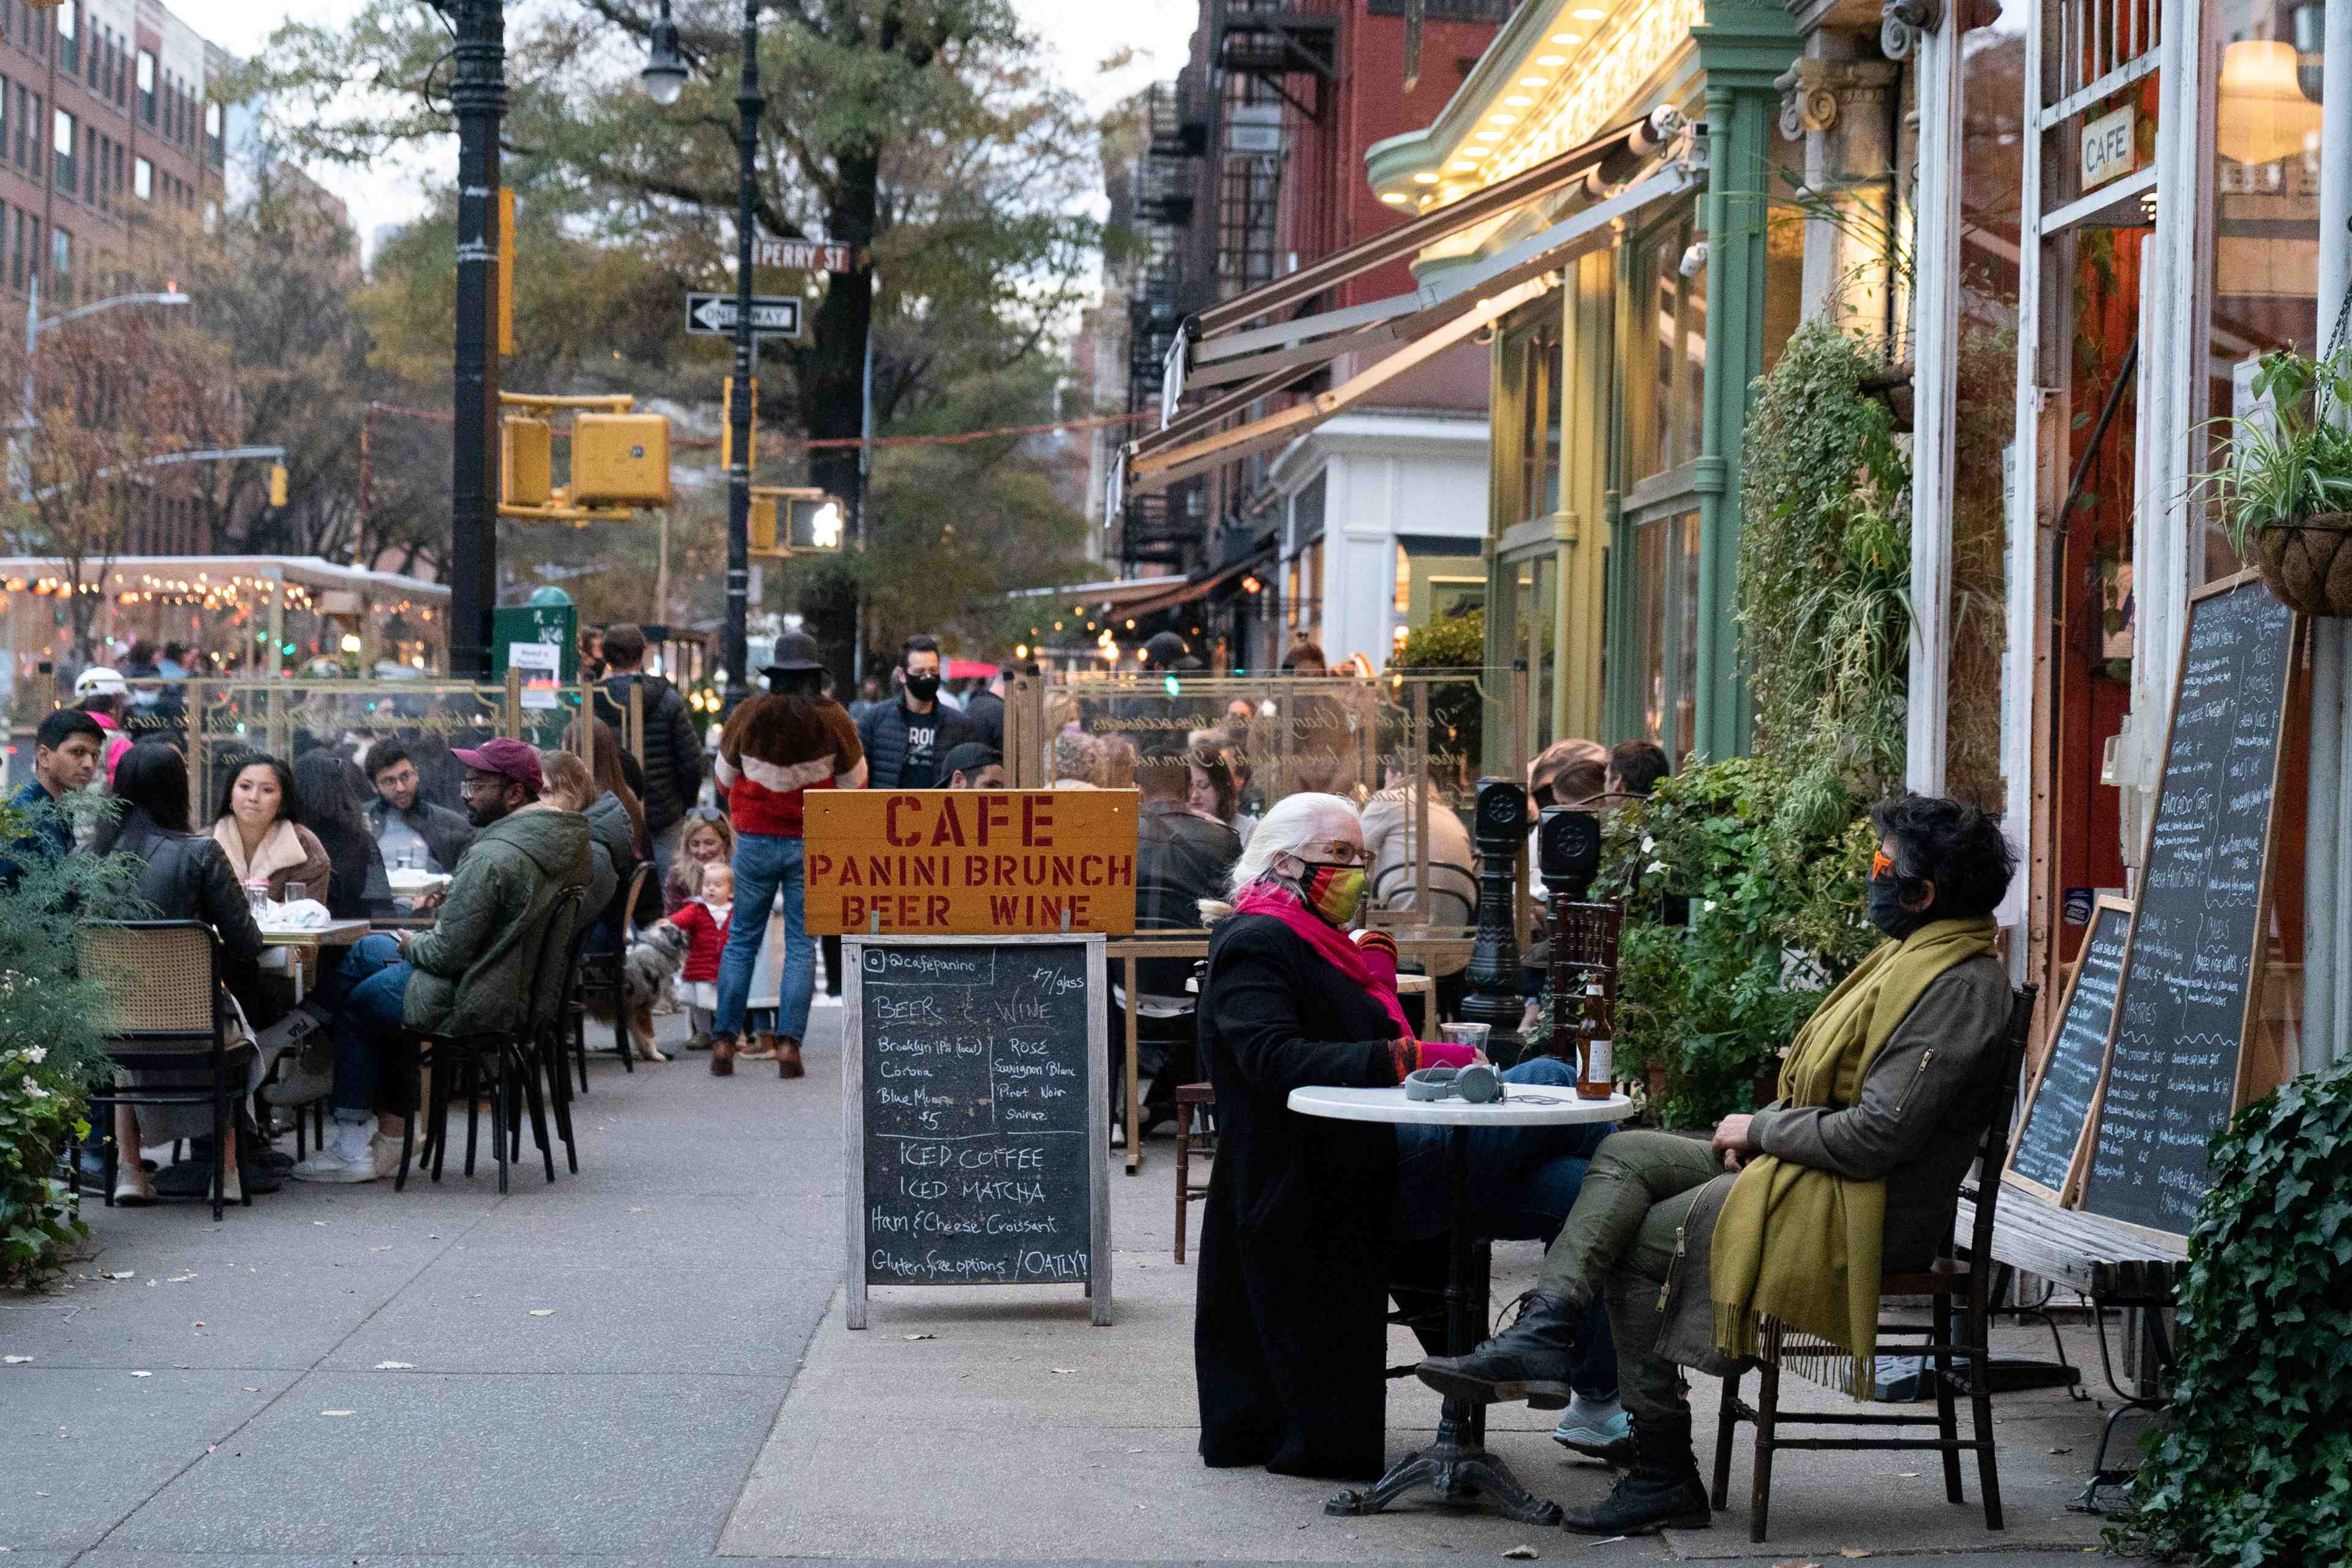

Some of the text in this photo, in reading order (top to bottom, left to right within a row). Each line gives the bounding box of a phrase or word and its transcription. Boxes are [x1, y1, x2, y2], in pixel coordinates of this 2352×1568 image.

[2086, 124, 2126, 173] CAFE
[761, 244, 843, 270] PERRY ST
[752, 308, 782, 320] WAY
[909, 726, 935, 746] ROI
[2162, 790, 2193, 816] AVOCADO
[886, 796, 1053, 847] CAFE
[810, 855, 1131, 886] PANINI BRUNCH
[842, 895, 1090, 926] BEER WINE
[873, 996, 944, 1020] BEER
[994, 988, 1052, 1023] WINE
[2124, 993, 2157, 1026] PASTRIES
[878, 1037, 932, 1057] Brooklyn
[881, 1061, 933, 1077] Corona
[994, 1058, 1076, 1079] Sauvignon Blanc
[877, 1087, 912, 1106] Blue
[997, 1083, 1066, 1101] Pinot Noir
[919, 1111, 941, 1131] $5
[900, 1142, 1044, 1169] ICED COFFEE
[900, 1175, 1044, 1205] ICED MATCHA
[872, 1205, 909, 1232] Ham
[924, 1212, 981, 1234] Cheese
[987, 1214, 1057, 1235] Croissant
[872, 1250, 925, 1276] Gluten
[926, 1250, 956, 1280] free
[957, 1260, 1005, 1280] options
